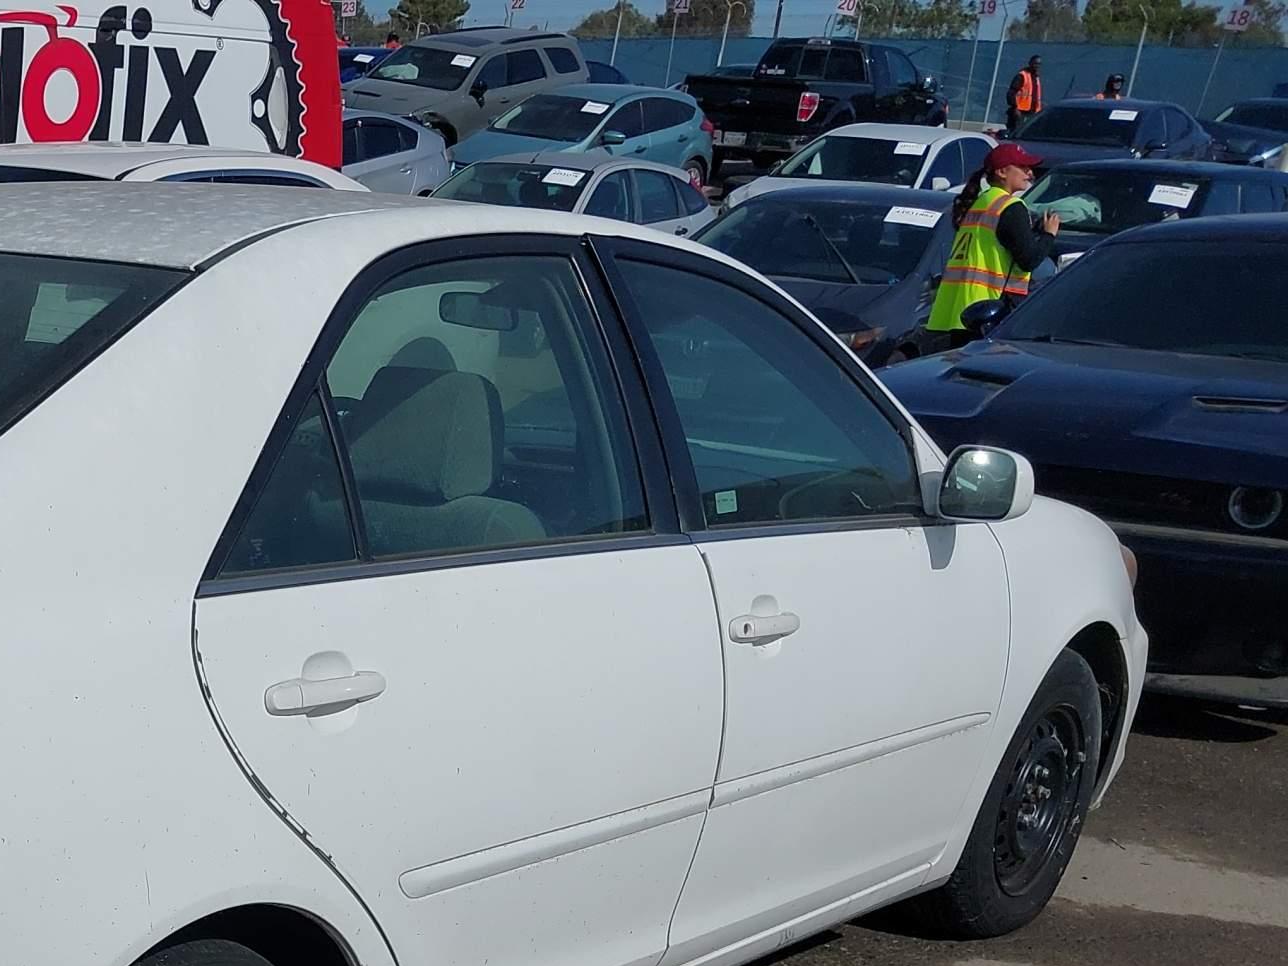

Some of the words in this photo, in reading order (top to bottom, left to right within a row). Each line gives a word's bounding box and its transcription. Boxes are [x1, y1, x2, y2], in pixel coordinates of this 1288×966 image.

[343, 2, 355, 13] 23
[511, 0, 526, 9] 22
[675, 0, 689, 9] 21
[837, 0, 856, 11] 20
[978, 0, 996, 14] 19
[1227, 10, 1250, 26] 18
